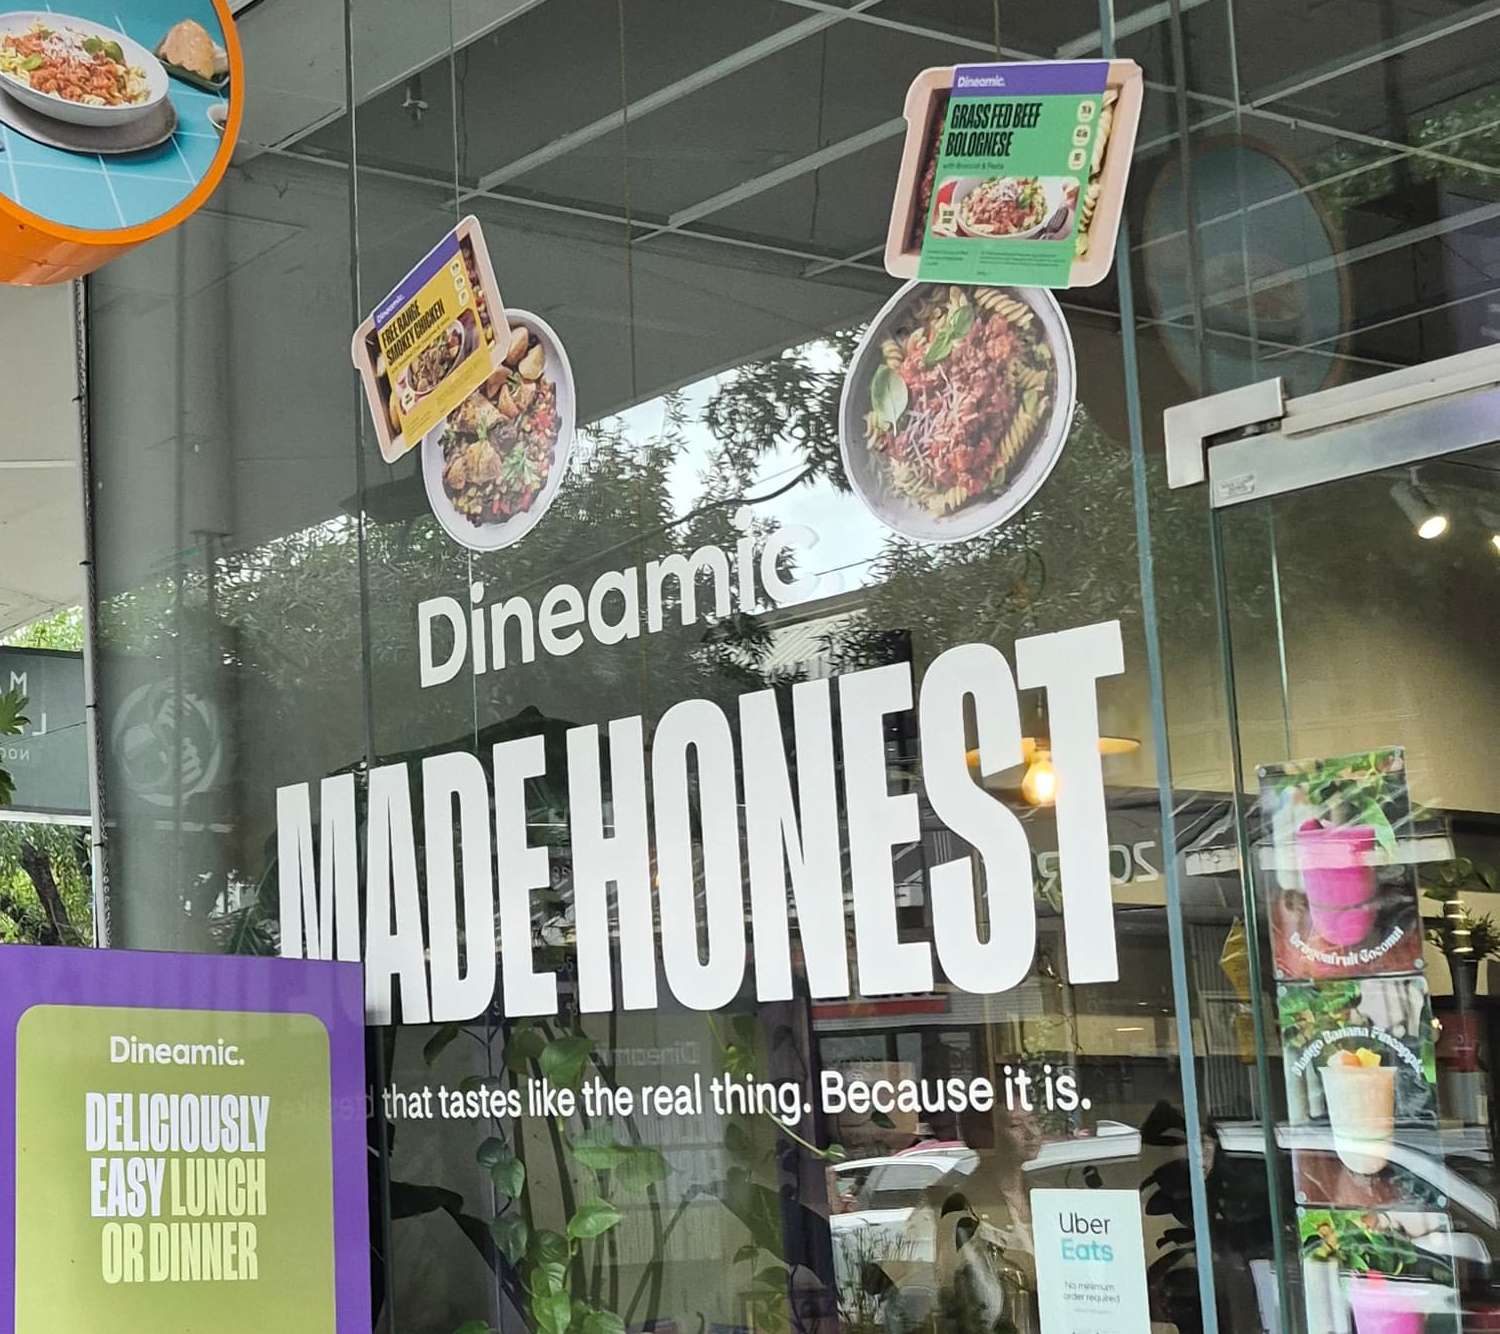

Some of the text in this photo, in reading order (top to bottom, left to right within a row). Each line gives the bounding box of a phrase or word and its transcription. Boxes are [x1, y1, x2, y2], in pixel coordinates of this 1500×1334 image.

[944, 131, 1015, 157] BOLOGNESE
[950, 102, 1043, 129] GRASS FED BEEF
[386, 326, 416, 366] SMOKEY
[413, 298, 446, 340] CHICKEN
[275, 618, 1126, 1027] MADE HONEST
[109, 1035, 245, 1066] Dineamic.
[85, 1092, 270, 1153] DELICIOUSLY
[381, 1083, 434, 1119] that
[437, 1084, 521, 1118] tastes
[527, 1077, 575, 1117] like
[581, 1075, 633, 1117] the
[642, 1072, 702, 1115] real
[709, 1071, 811, 1127] thing.
[820, 1070, 994, 1114] Because
[1003, 1065, 1034, 1112] it
[1043, 1064, 1092, 1112] is.
[90, 1157, 267, 1217] EASY LUNCH
[101, 1221, 258, 1284] OR DINNER
[1059, 1212, 1111, 1235] Uber
[1060, 1238, 1114, 1262] Eats
